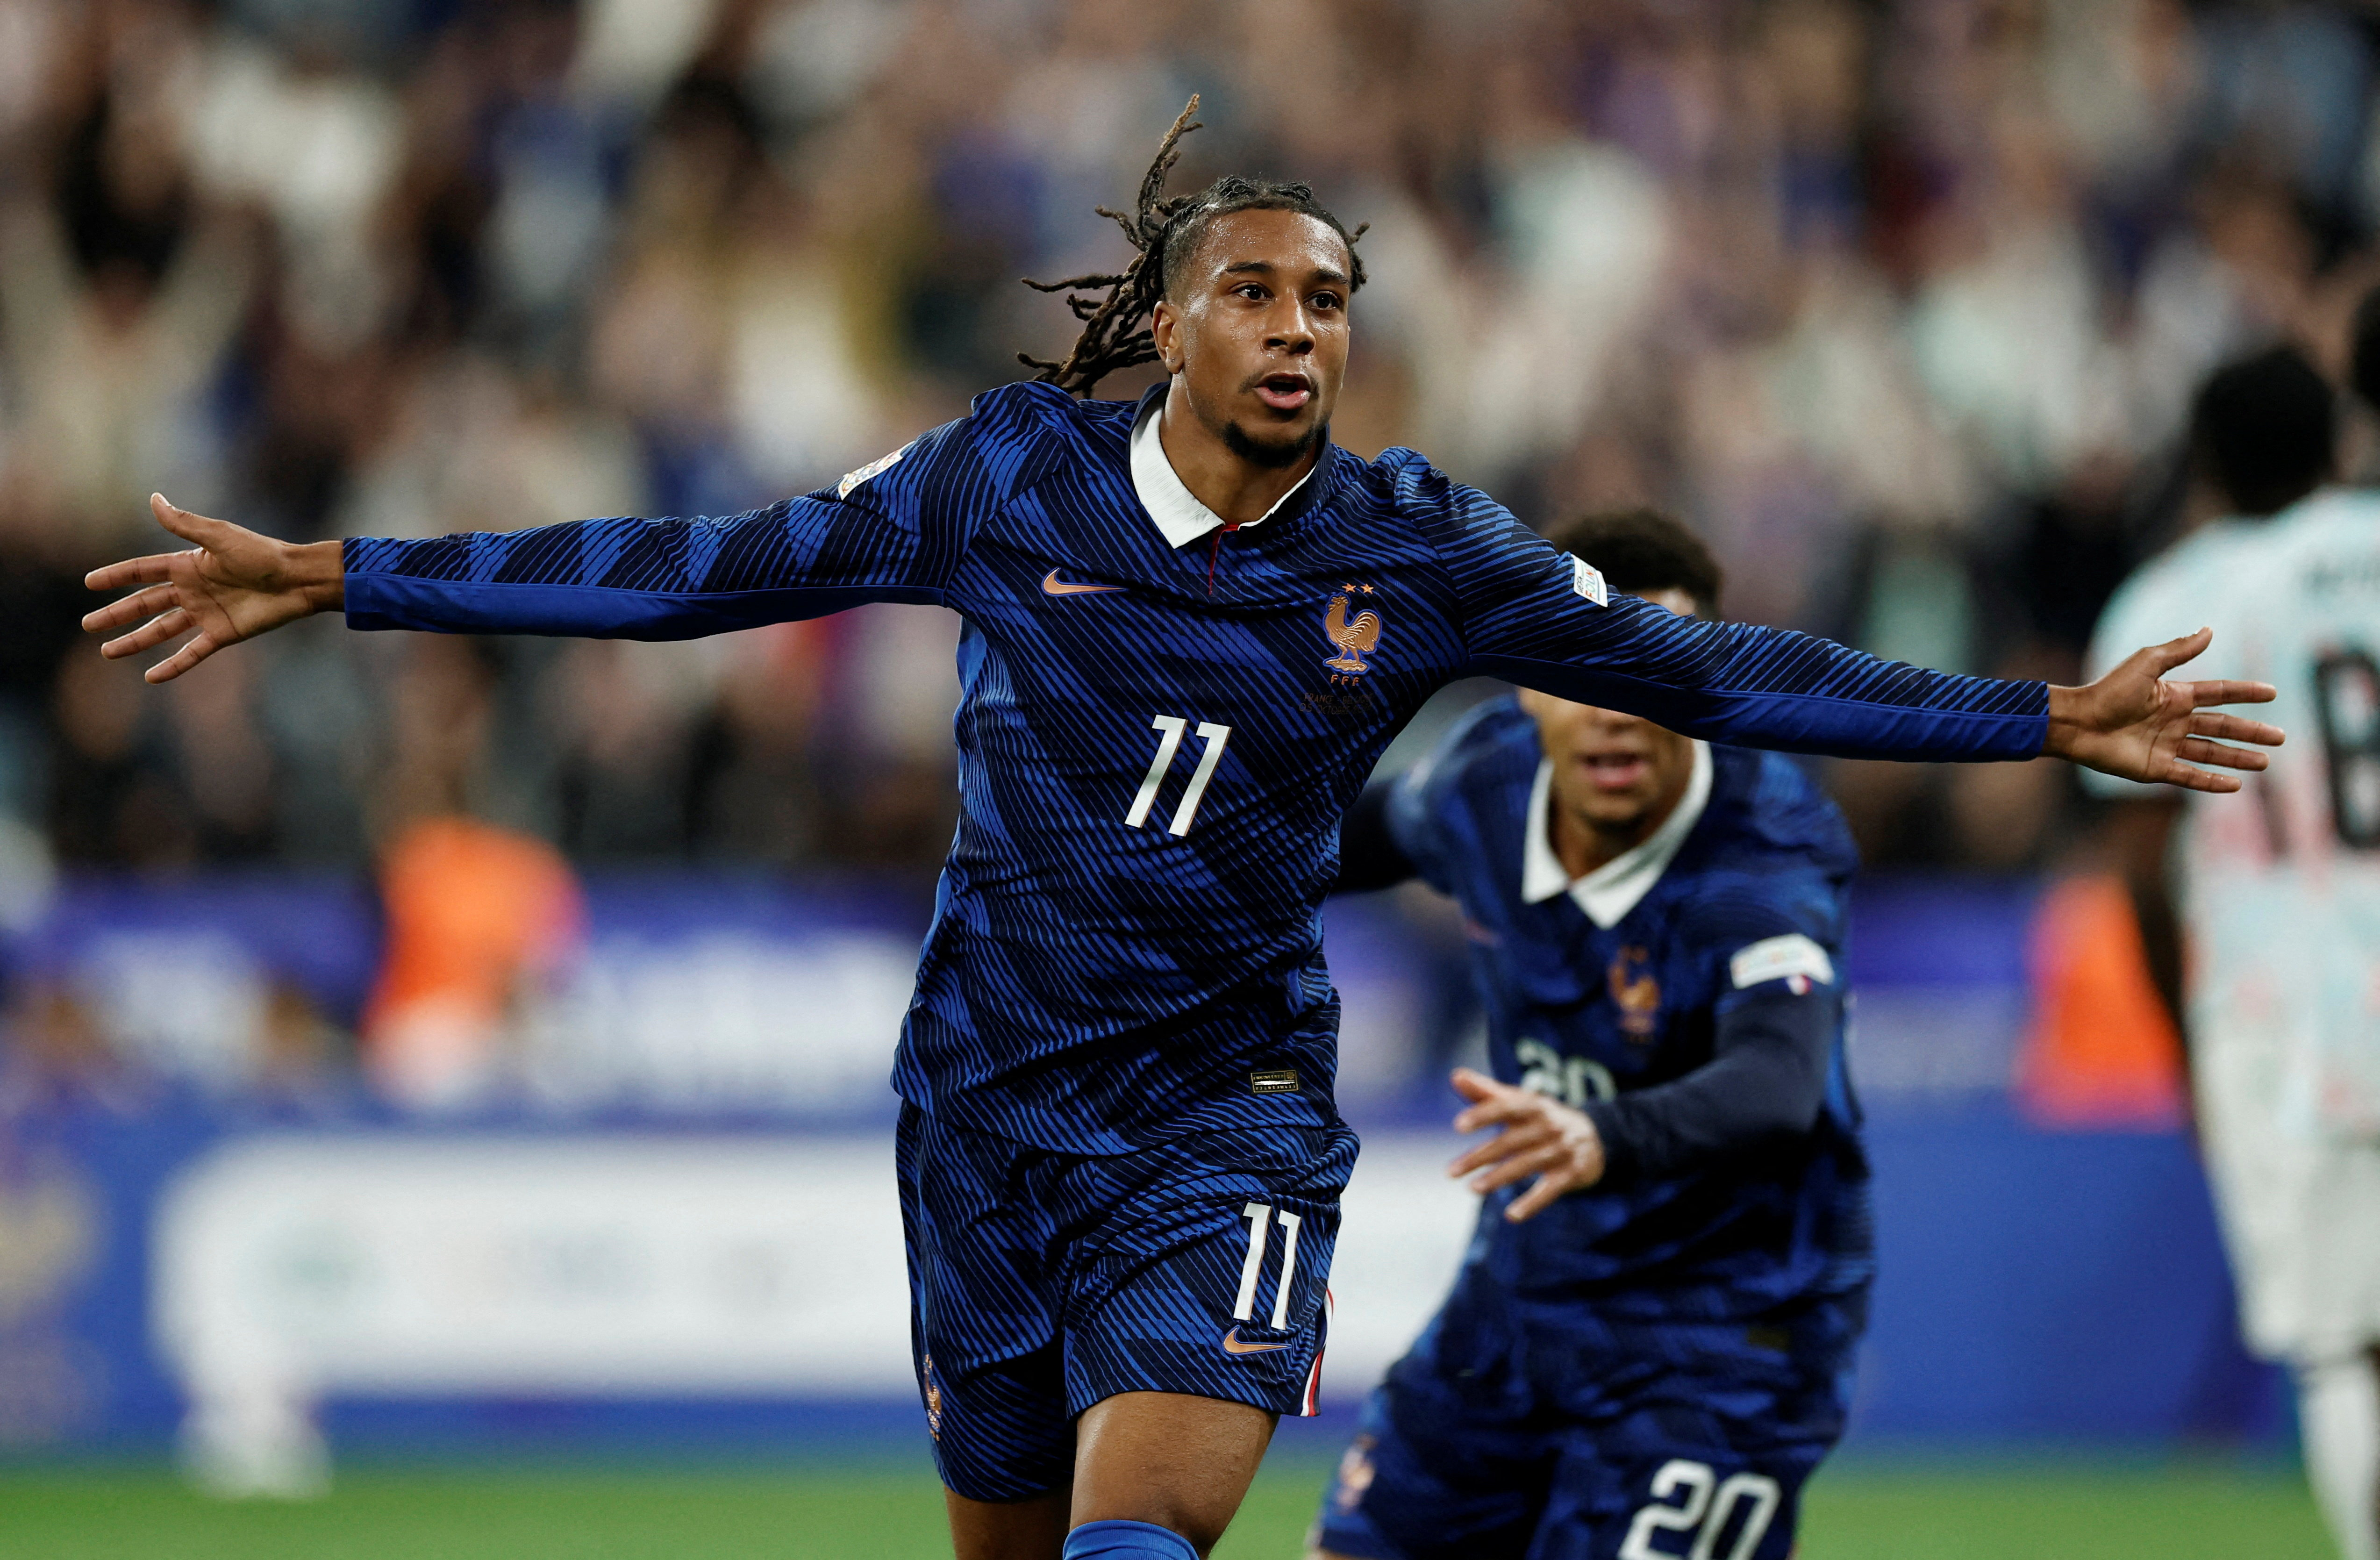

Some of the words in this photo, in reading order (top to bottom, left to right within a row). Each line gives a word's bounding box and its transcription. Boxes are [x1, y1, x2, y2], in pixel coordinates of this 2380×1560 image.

[1330, 674, 1359, 686] FFF
[1124, 714, 1232, 837] 11
[1233, 1202, 1302, 1330] 11
[1617, 1458, 1782, 1560] 20
